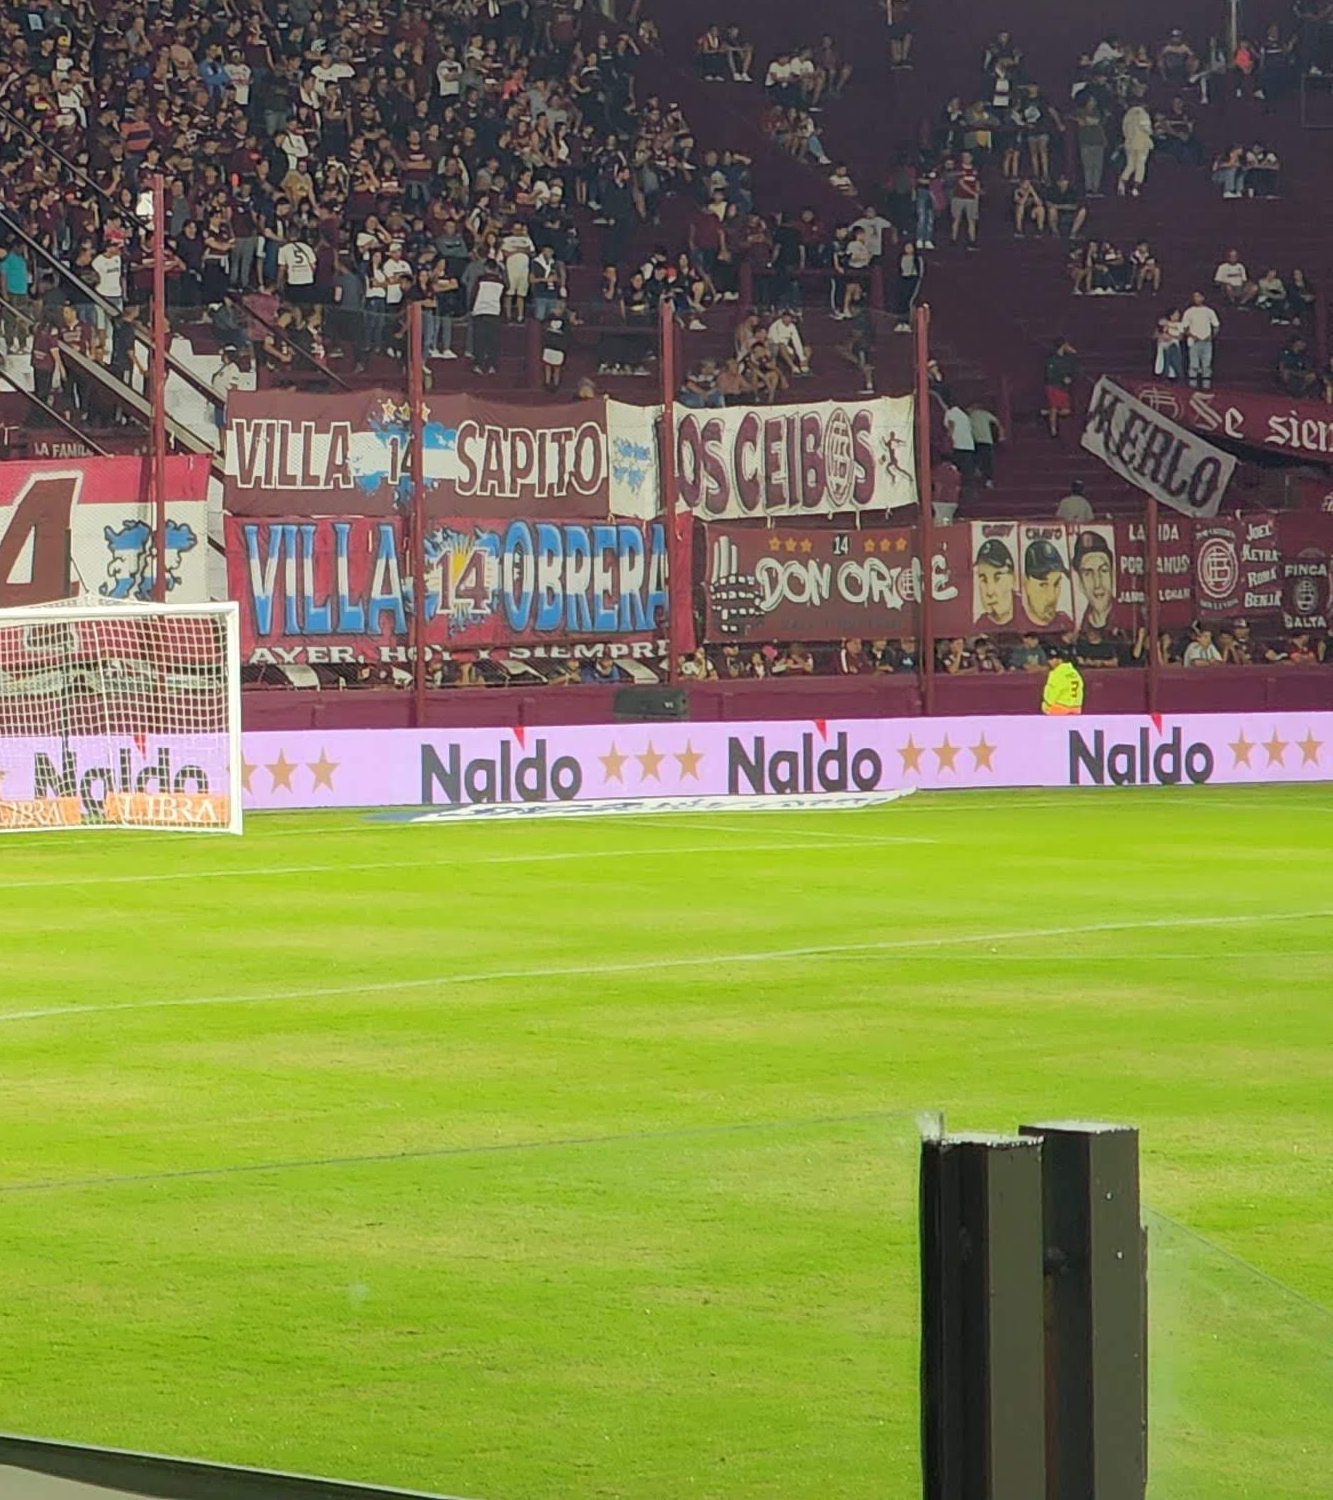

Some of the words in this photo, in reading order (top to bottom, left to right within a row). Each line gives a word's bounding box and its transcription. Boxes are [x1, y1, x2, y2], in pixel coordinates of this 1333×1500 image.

[1190, 391, 1245, 439] Se
[233, 418, 355, 490] VILLA
[454, 419, 607, 498] SAPITO
[834, 535, 849, 555] 14
[1129, 524, 1146, 541] LA
[1155, 524, 1180, 541] IDA
[243, 521, 408, 637] VILLA
[432, 547, 494, 615] 14
[503, 520, 670, 633] OBRERA
[756, 557, 832, 611] DON
[1155, 554, 1191, 574] ANUS
[1283, 564, 1329, 578] FINCA
[421, 738, 582, 804] Naldo
[728, 731, 883, 796] Naldo
[1068, 725, 1214, 786] Naldo
[120, 793, 219, 823] LIBRA
